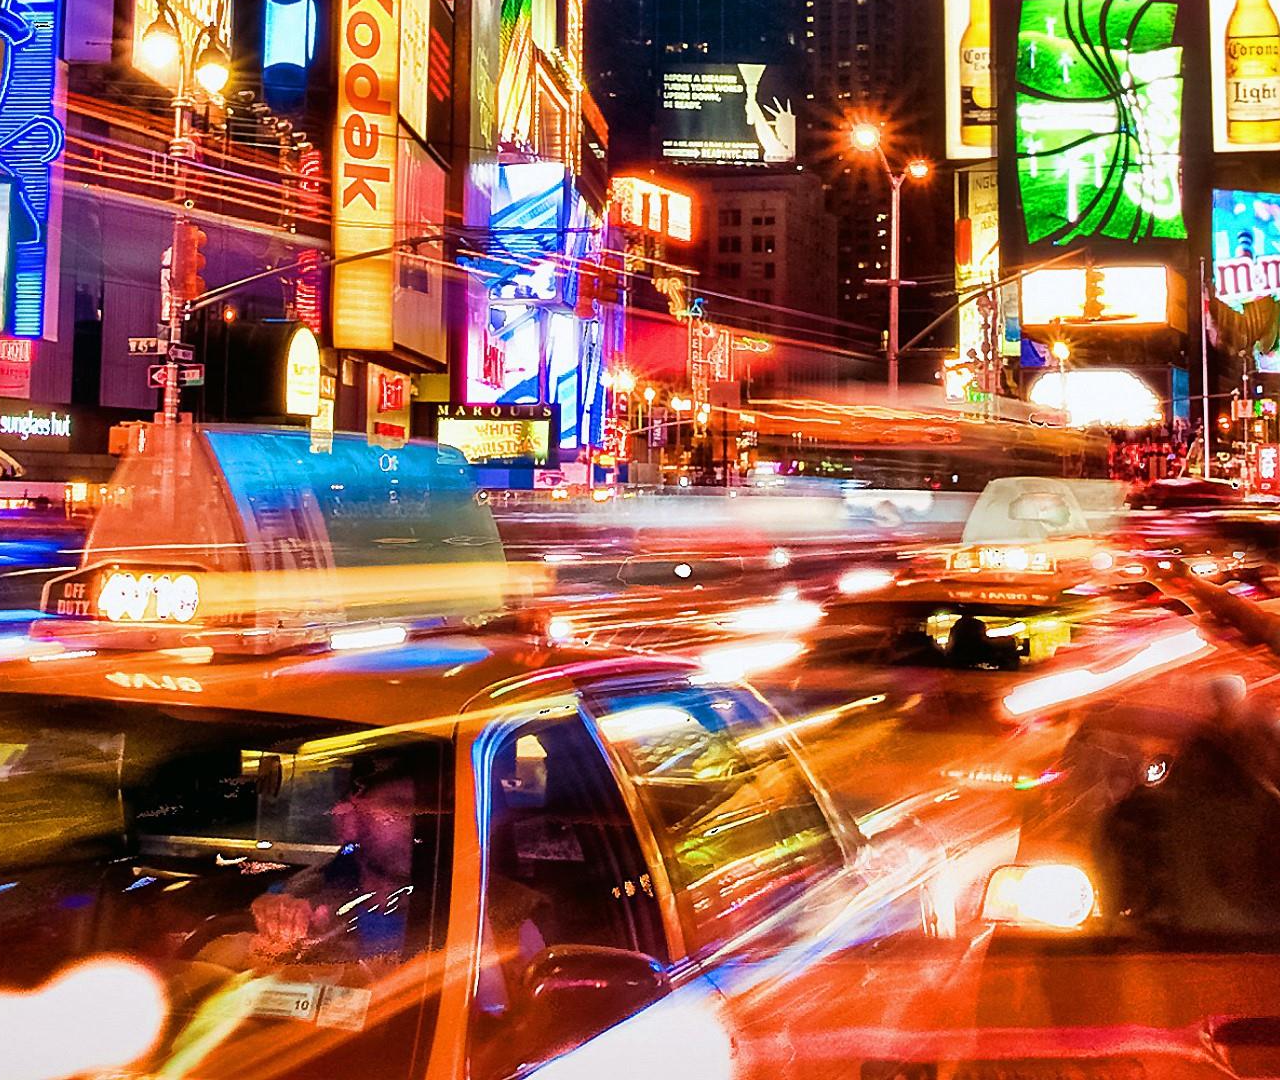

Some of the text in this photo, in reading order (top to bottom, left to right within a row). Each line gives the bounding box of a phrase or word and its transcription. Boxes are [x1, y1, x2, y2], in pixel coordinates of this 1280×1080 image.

[437, 404, 552, 417] MARQUIS
[0, 409, 71, 440] sunglass hut
[475, 422, 523, 437] WHITE
[63, 582, 87, 600] OFF
[57, 599, 91, 616] DUTY
[295, 999, 310, 1011] 10
